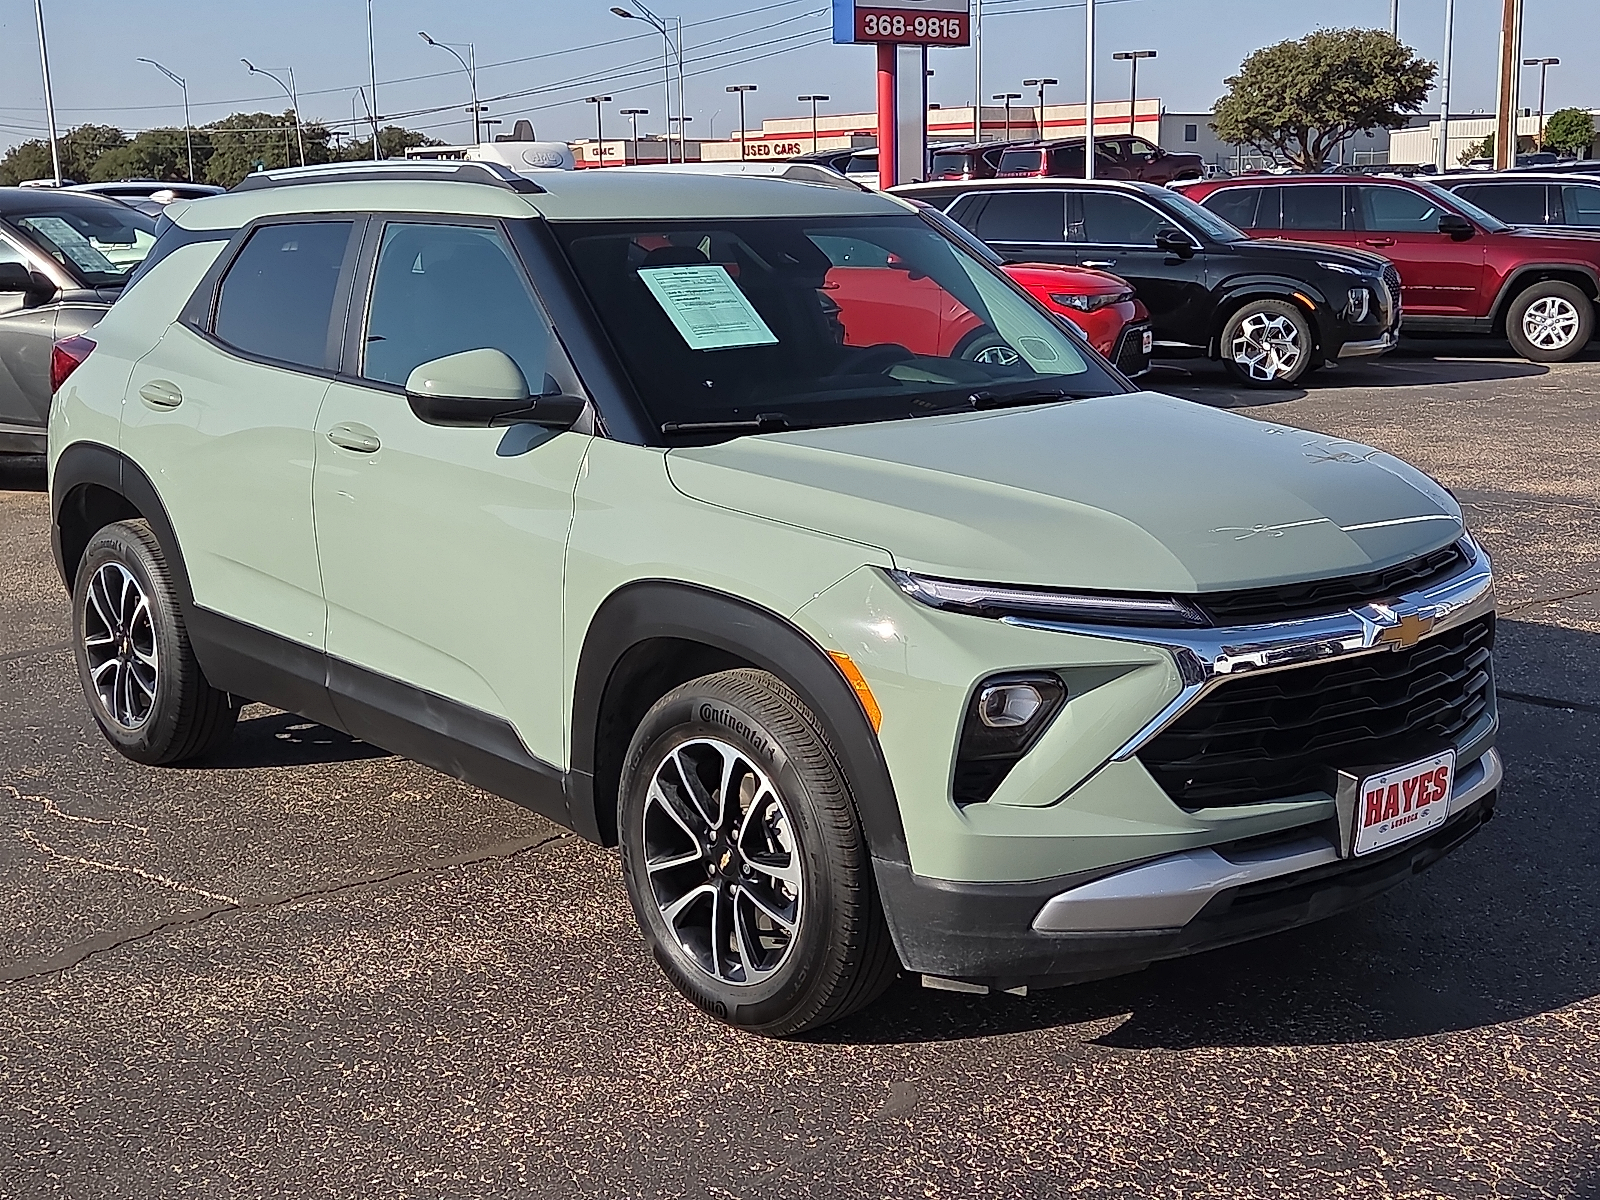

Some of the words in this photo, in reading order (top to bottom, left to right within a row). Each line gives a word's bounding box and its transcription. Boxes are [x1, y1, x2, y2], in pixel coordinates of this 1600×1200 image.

[864, 14, 960, 39] 368-9815
[744, 144, 770, 157] USED
[774, 142, 801, 156] CARS
[699, 702, 769, 753] Continental
[1363, 765, 1449, 829] HAYES
